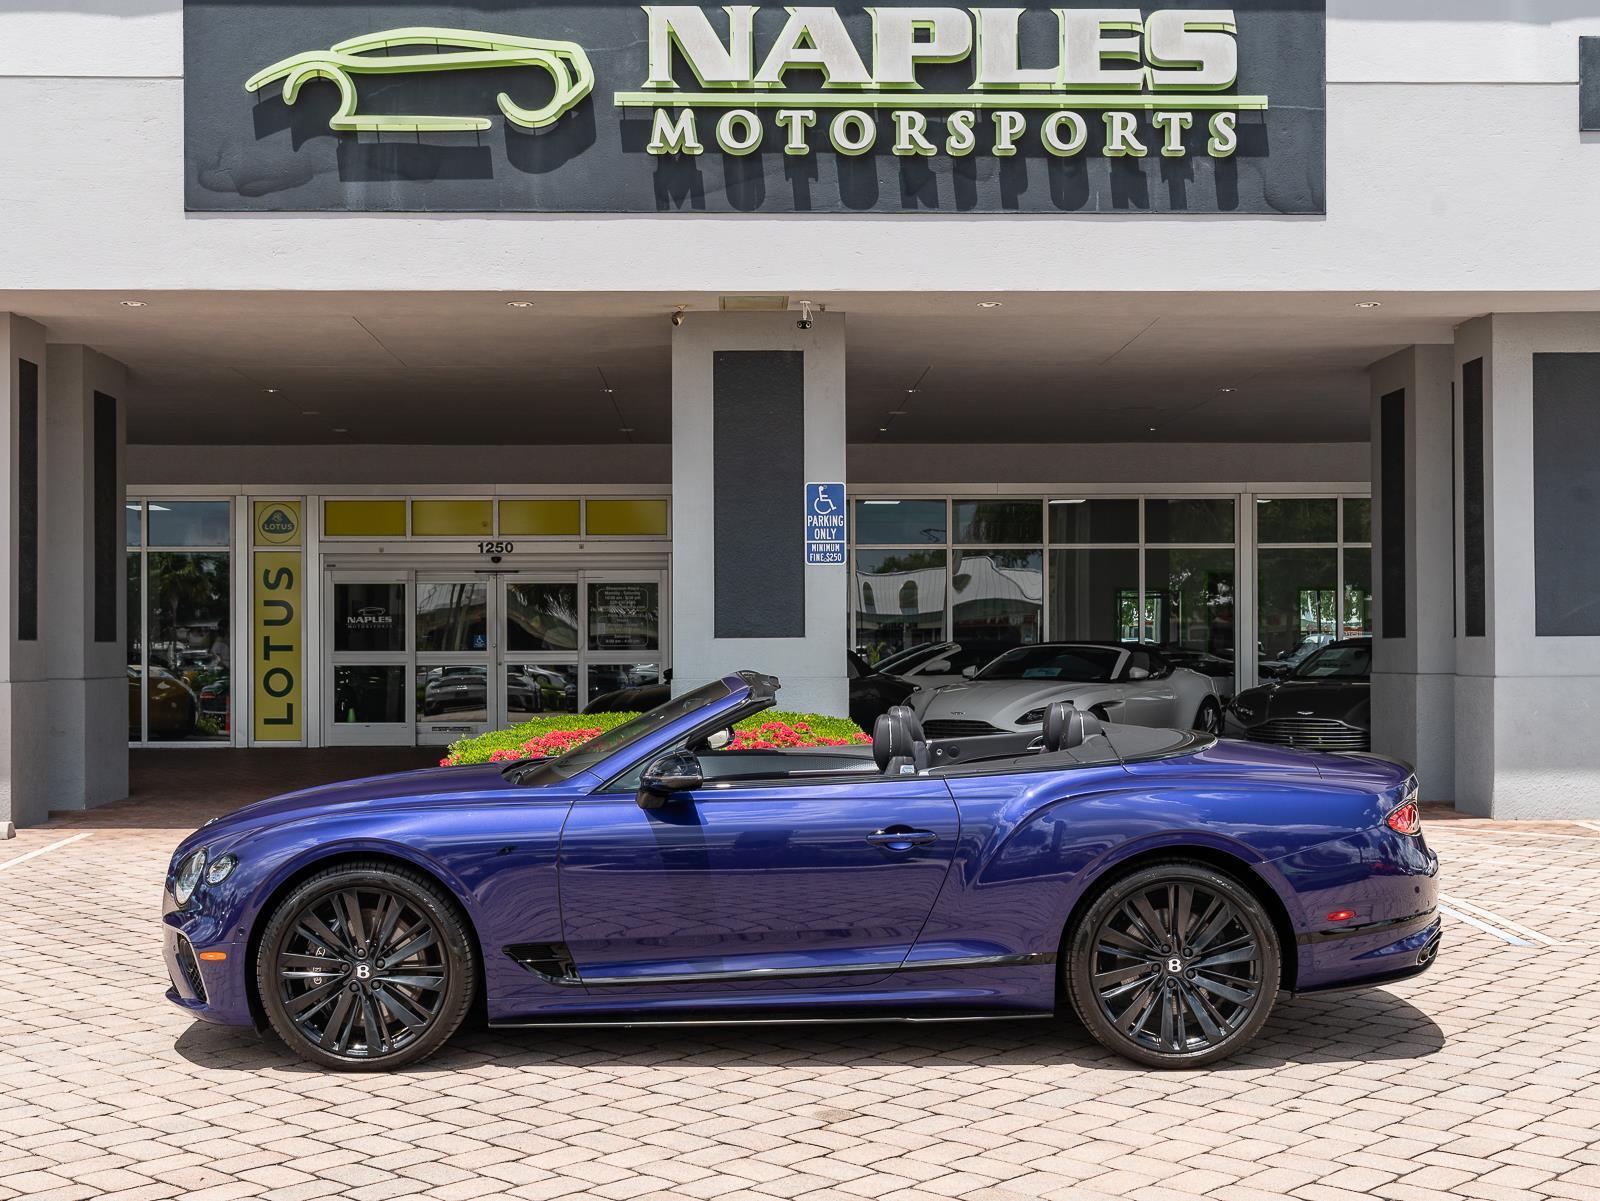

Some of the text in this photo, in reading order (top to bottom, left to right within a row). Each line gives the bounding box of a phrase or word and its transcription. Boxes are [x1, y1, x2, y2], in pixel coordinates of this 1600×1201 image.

[640, 5, 1238, 91] NAPLES
[646, 108, 1238, 158] MOTORSPORTS
[807, 515, 844, 527] PARKING
[814, 528, 837, 540] ONLY
[477, 541, 514, 554] 1250
[811, 543, 840, 552] MINIMUM
[809, 552, 842, 562] FINE $250
[263, 567, 294, 725] LOTUS
[356, 964, 370, 979] B
[1168, 958, 1182, 972] B
